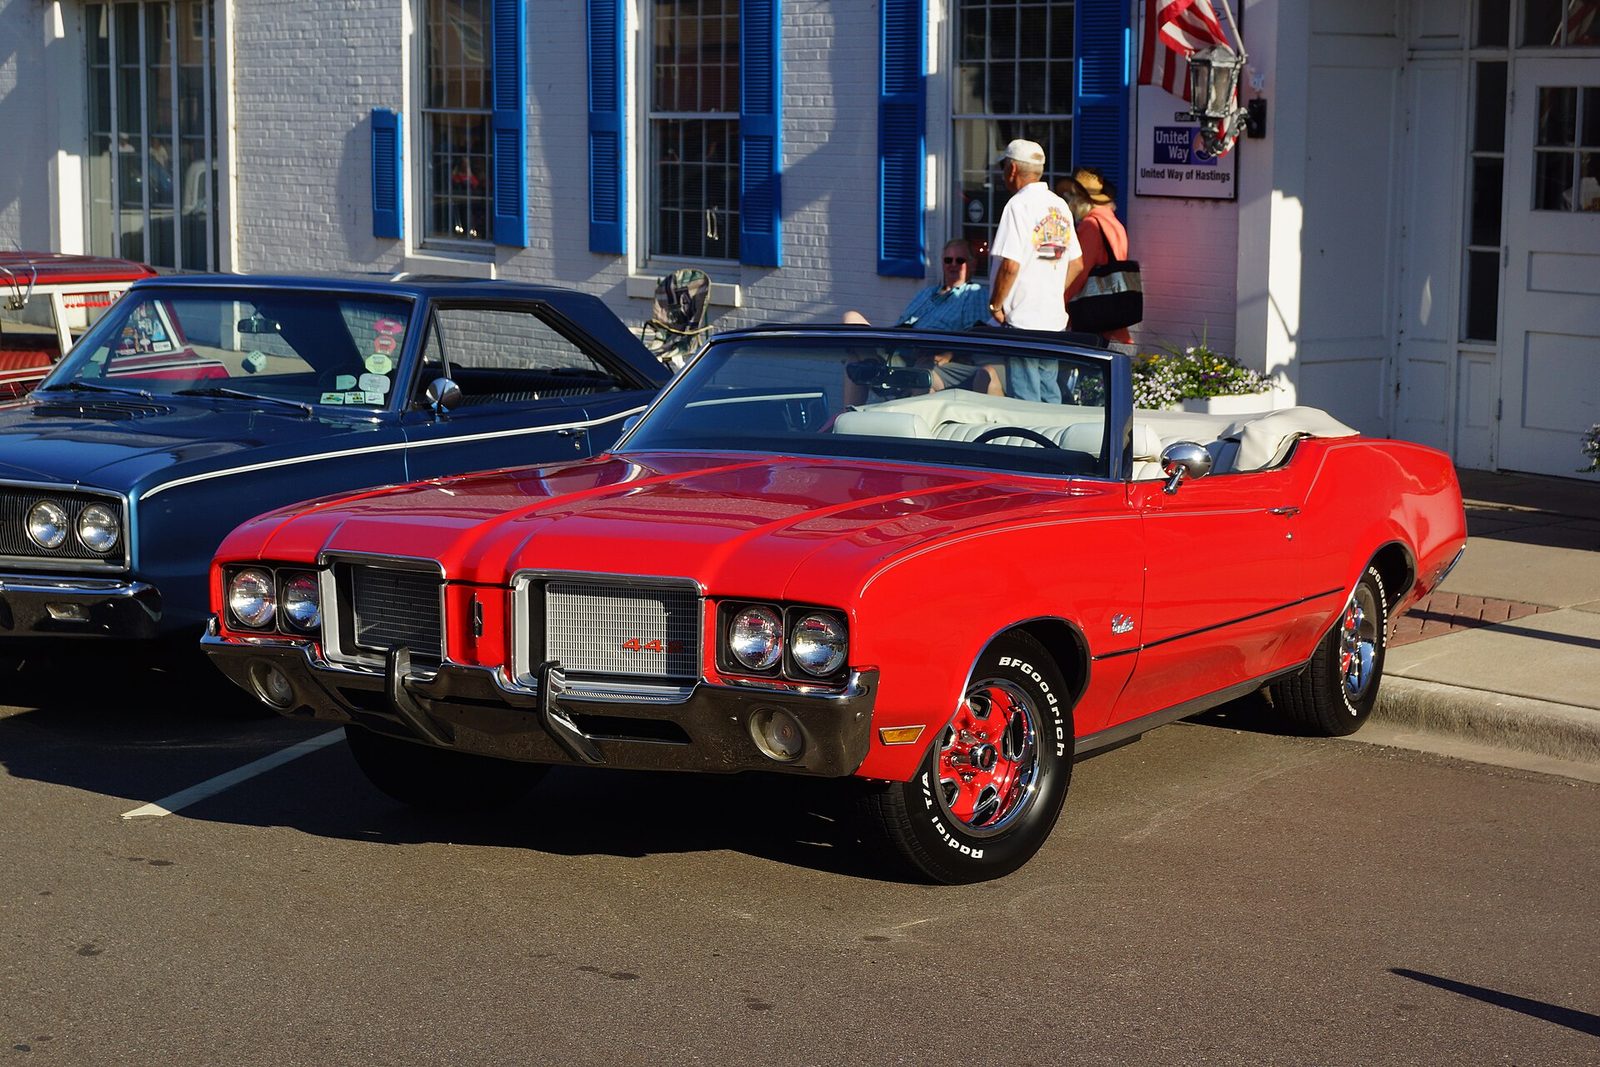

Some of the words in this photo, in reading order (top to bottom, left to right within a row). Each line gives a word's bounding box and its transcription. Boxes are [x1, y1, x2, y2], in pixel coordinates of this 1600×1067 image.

[1155, 130, 1189, 144] United
[1168, 145, 1189, 163] Way
[1141, 168, 1165, 179] United
[1167, 168, 1183, 181] Way
[1186, 169, 1193, 179] of
[1195, 170, 1230, 183] Hastings
[998, 656, 1064, 757] BFGoodrich
[921, 771, 933, 810] T/A
[931, 816, 984, 859] Radial
